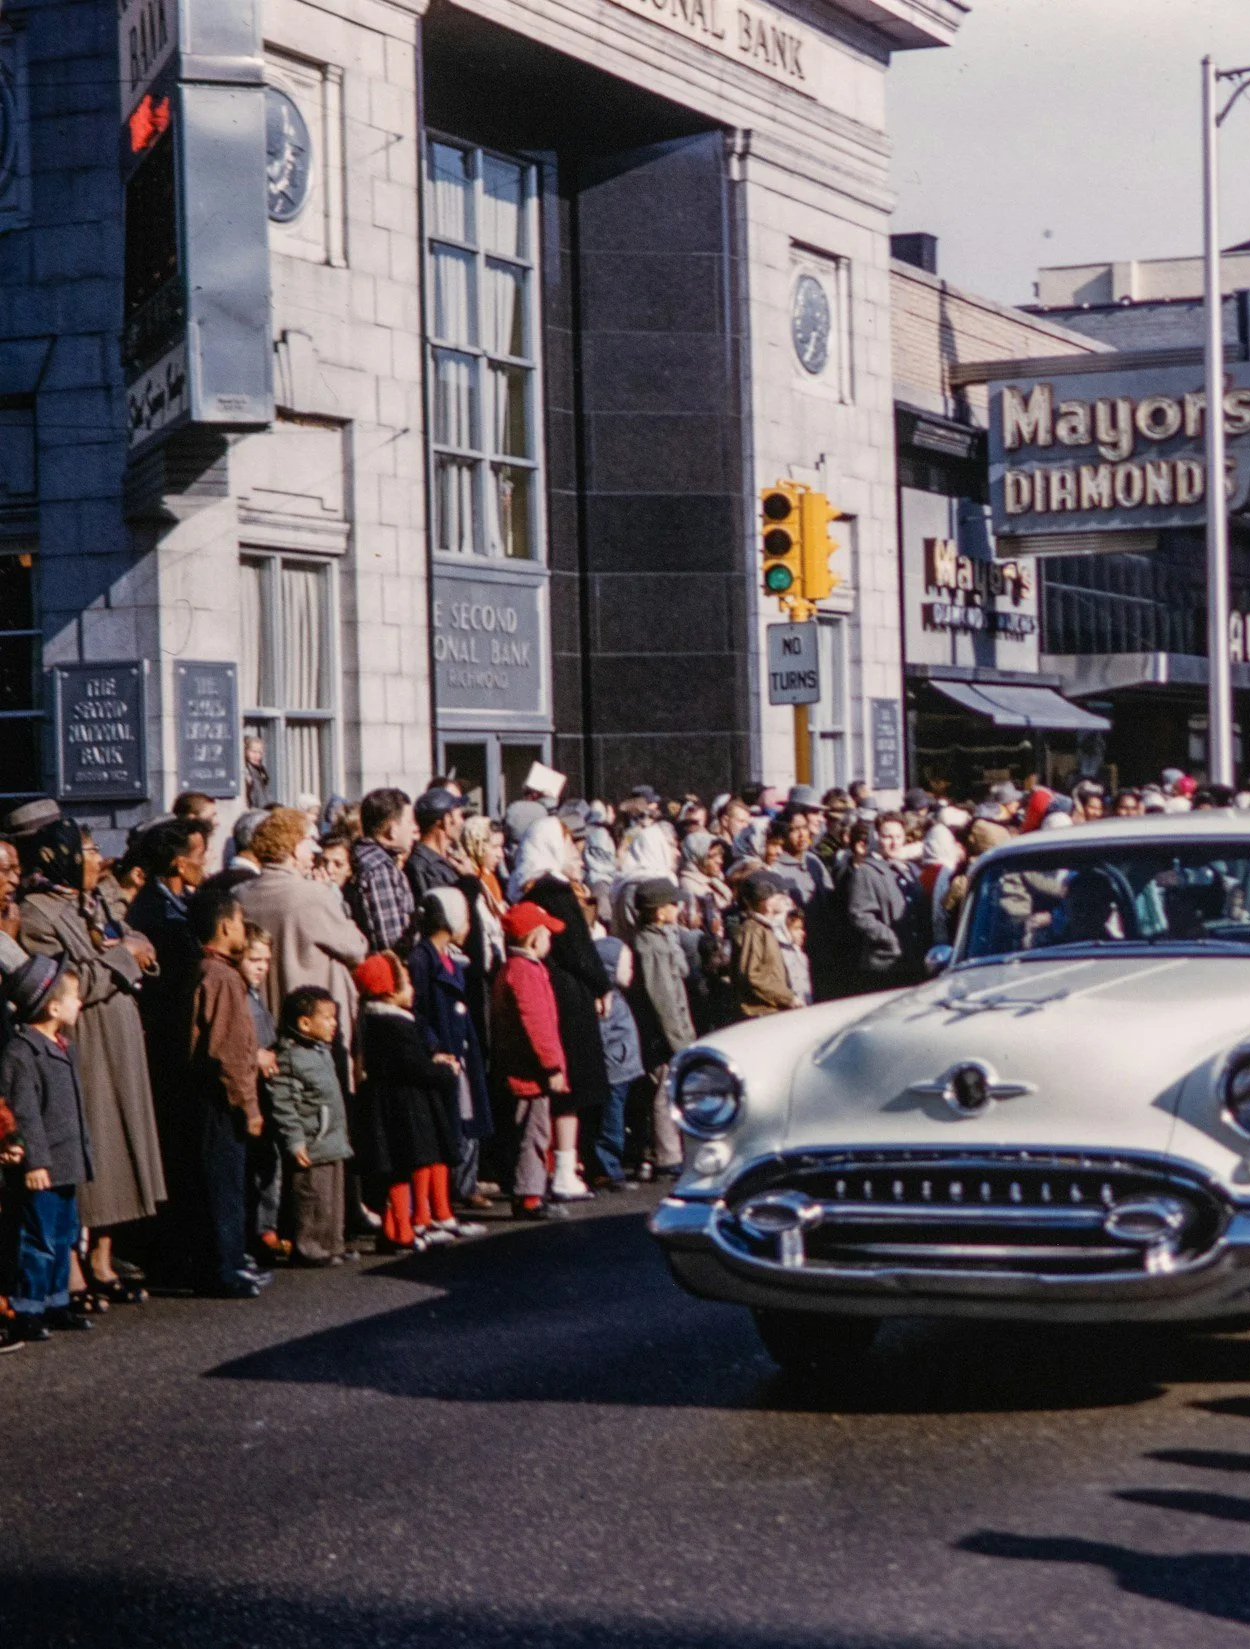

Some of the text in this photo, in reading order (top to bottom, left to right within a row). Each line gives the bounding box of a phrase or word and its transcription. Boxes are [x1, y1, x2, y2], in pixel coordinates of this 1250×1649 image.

[737, 8, 807, 81] BANK
[449, 602, 518, 634] SECOND
[490, 638, 530, 666] BANK
[782, 638, 802, 655] NO
[772, 672, 817, 691] TURNS
